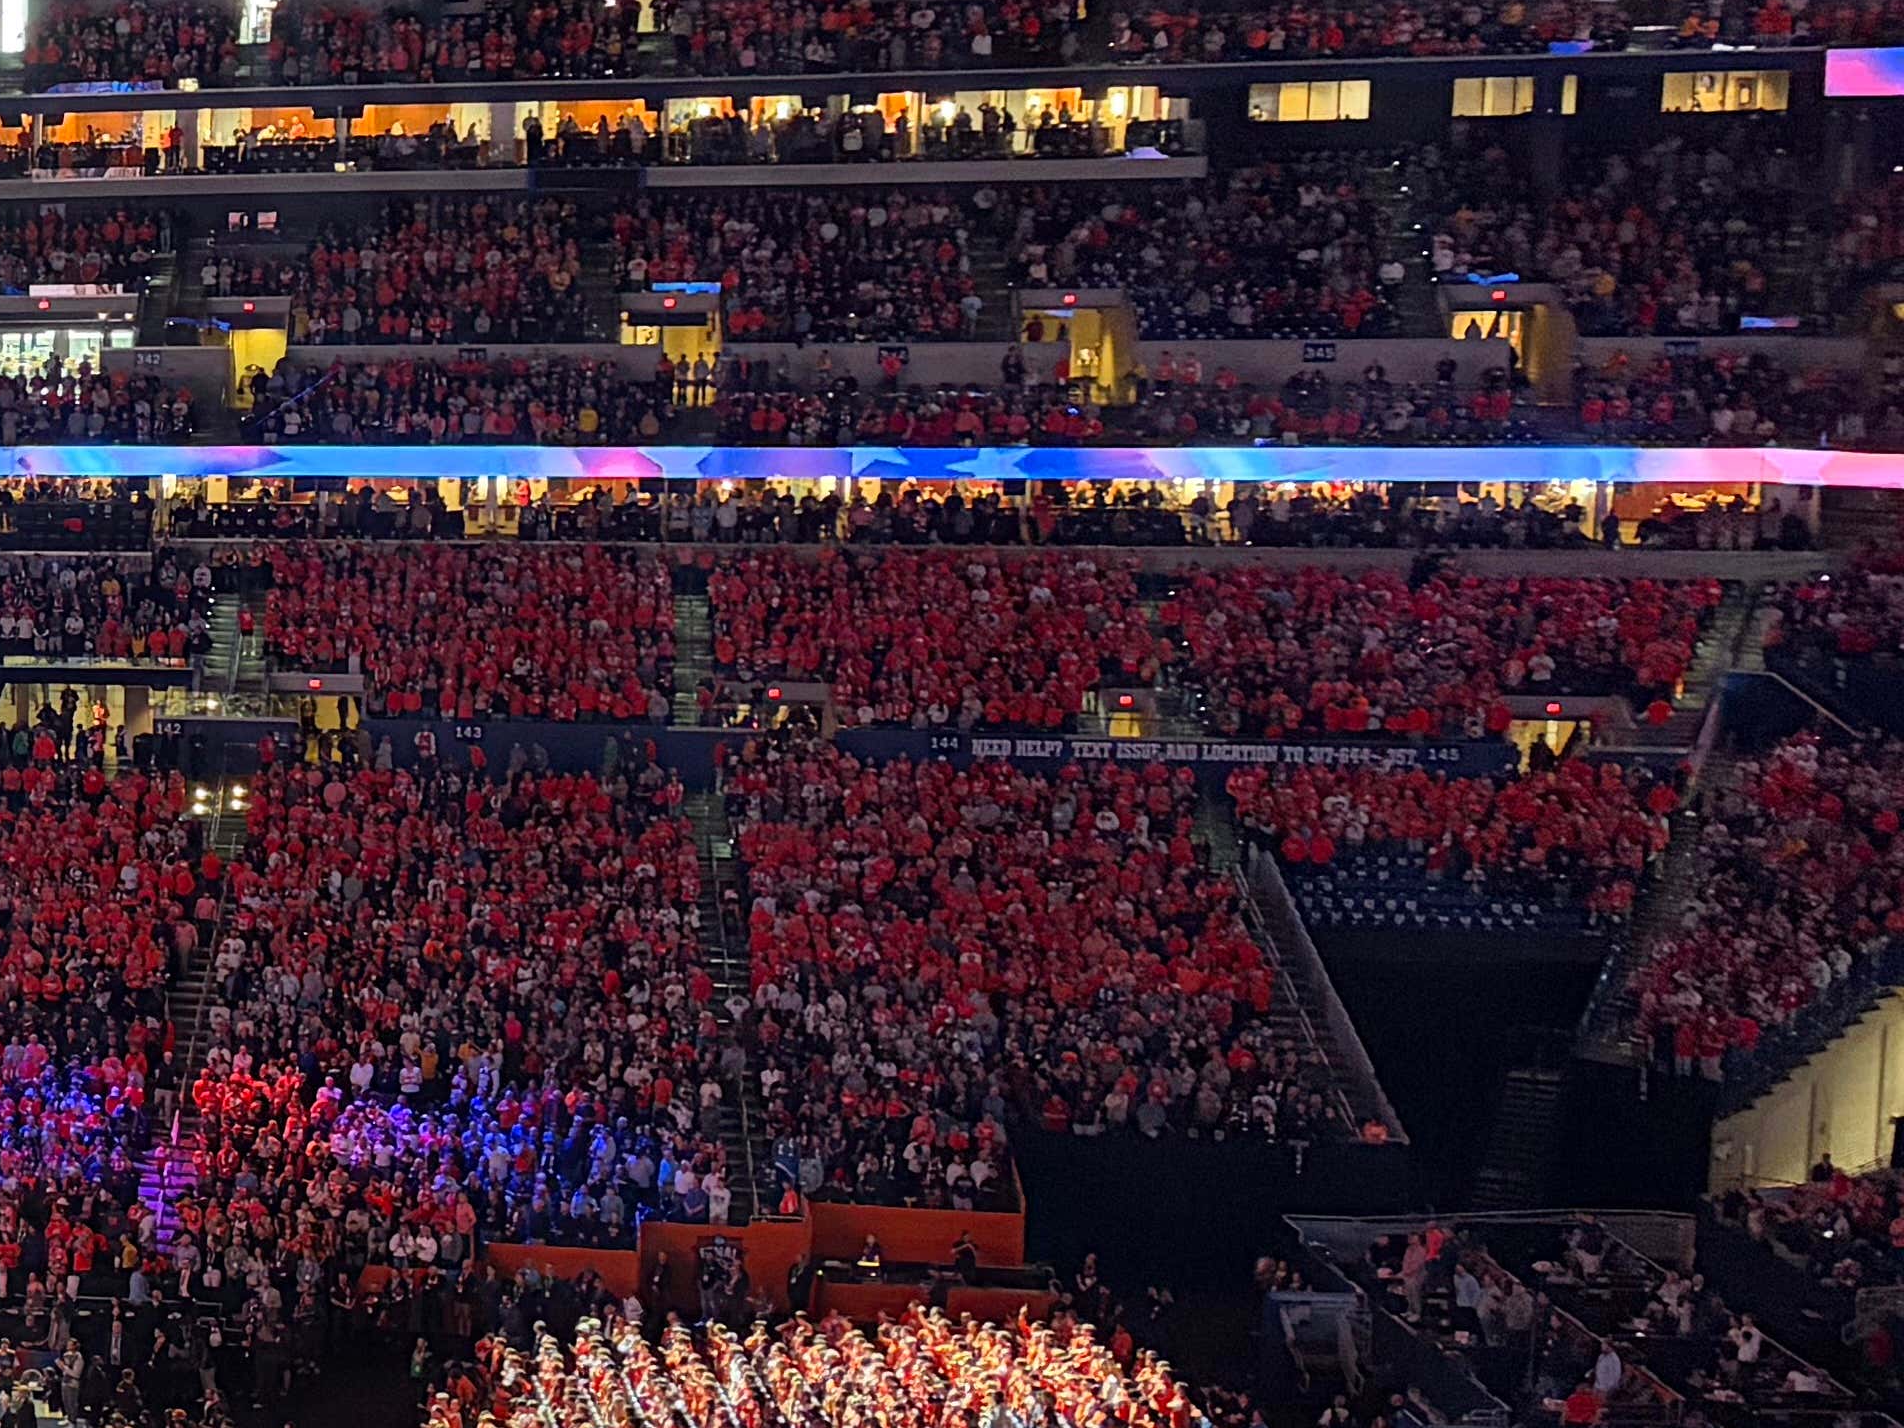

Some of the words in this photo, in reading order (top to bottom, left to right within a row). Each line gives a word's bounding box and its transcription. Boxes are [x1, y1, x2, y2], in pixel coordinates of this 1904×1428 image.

[136, 353, 161, 365] 342
[157, 722, 182, 735] 142
[456, 726, 482, 740] 143
[931, 736, 959, 749] 144
[971, 738, 1012, 756] NEED
[1016, 739, 1063, 757] HELP?
[1071, 741, 1113, 759] TEXT
[1166, 743, 1198, 760] AND
[1202, 744, 1279, 762] LOCATION
[1281, 745, 1304, 762] TO
[1428, 747, 1460, 762] 145
